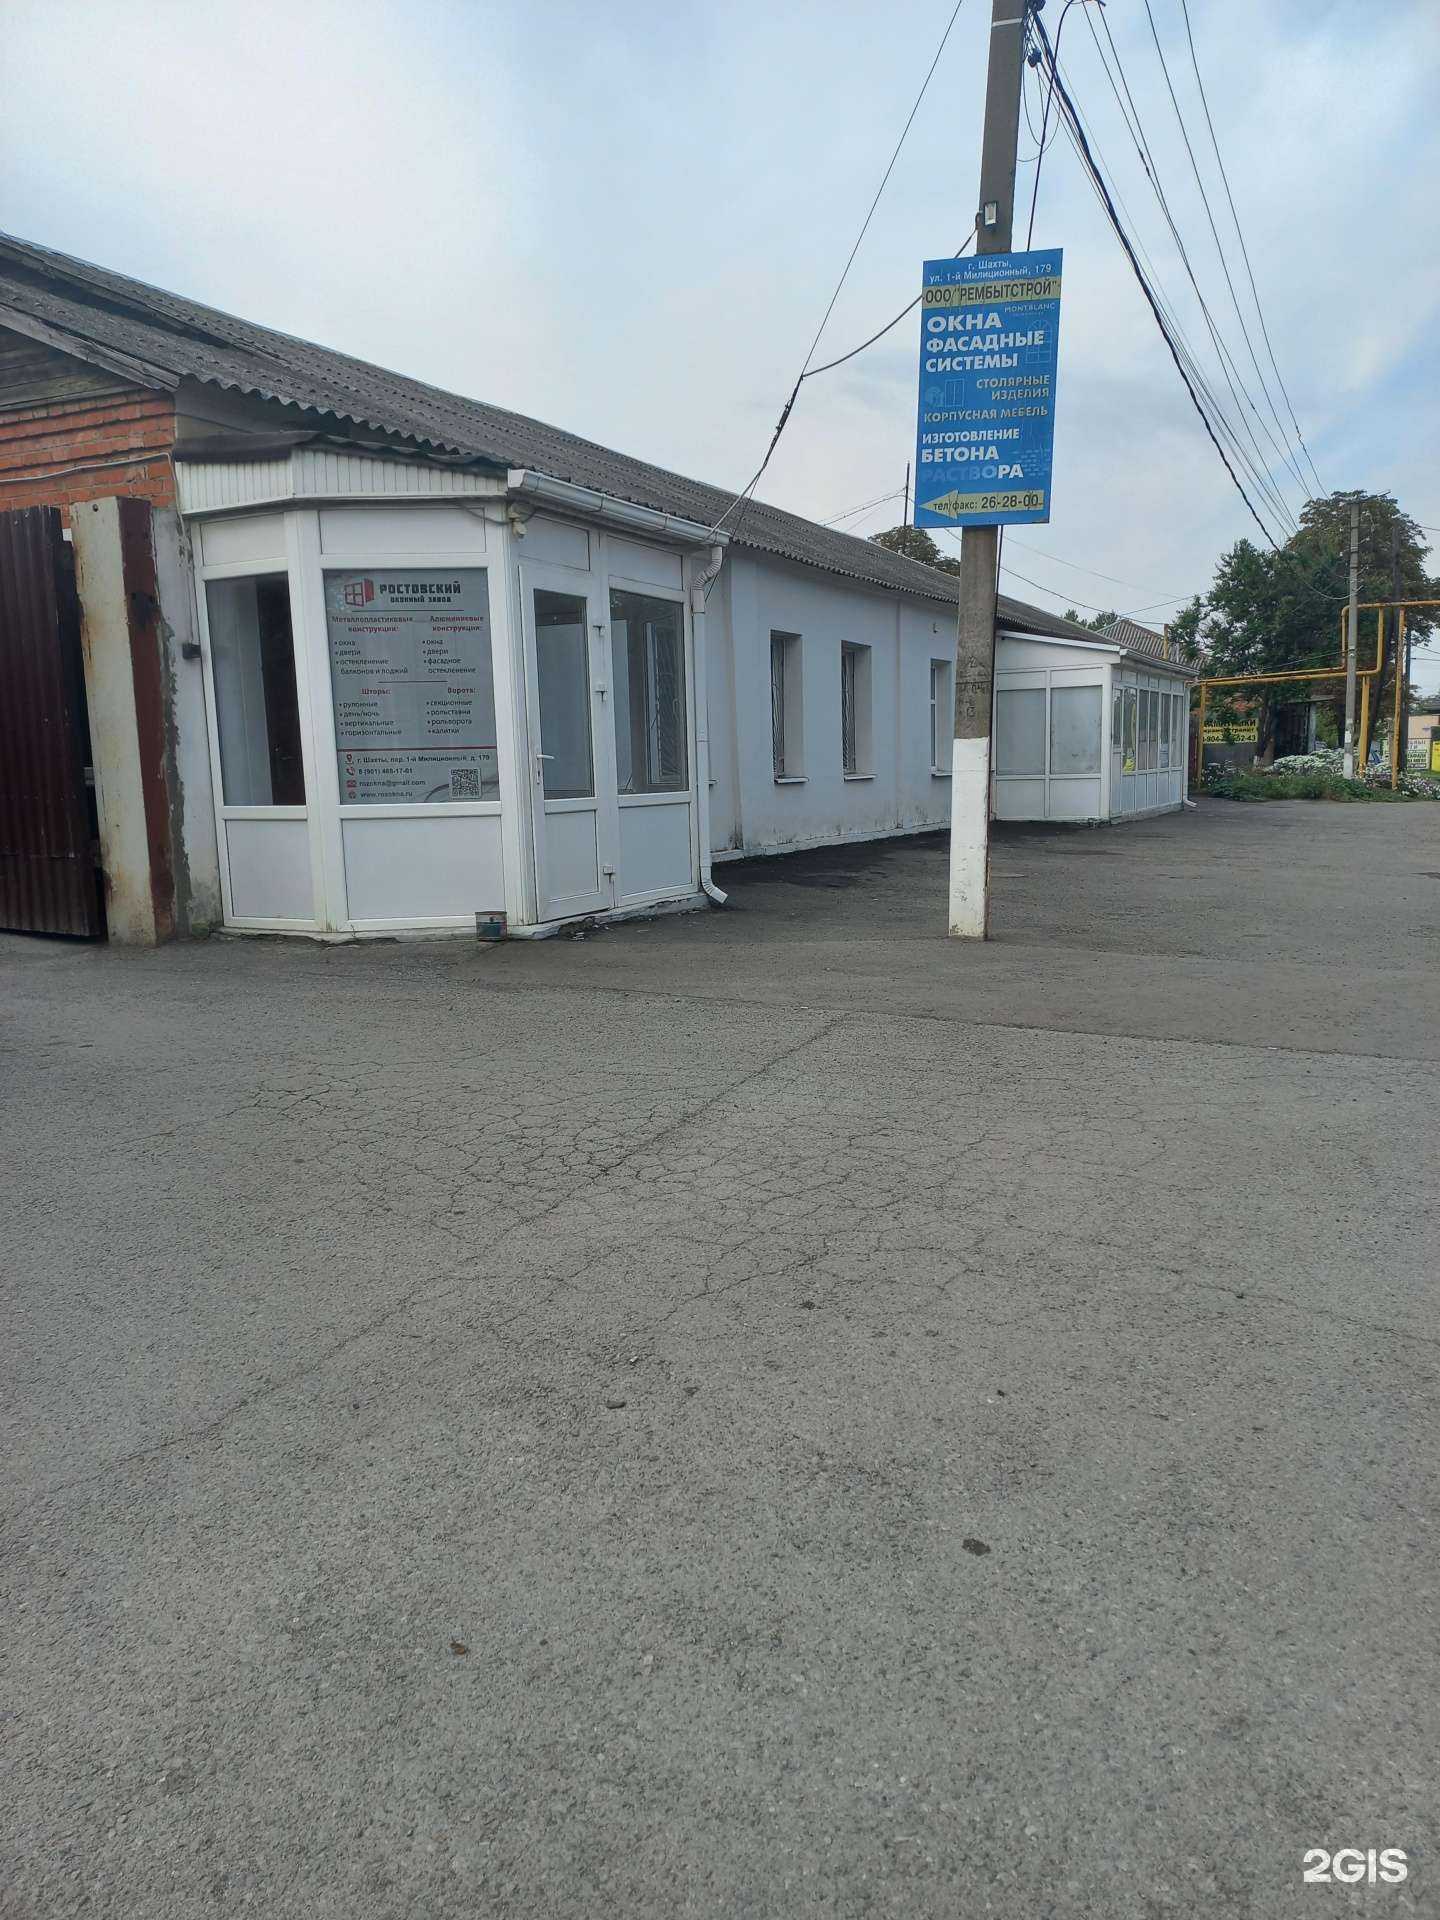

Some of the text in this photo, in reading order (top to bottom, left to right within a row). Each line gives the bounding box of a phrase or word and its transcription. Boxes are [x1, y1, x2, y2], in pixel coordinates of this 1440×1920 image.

[978, 260, 1012, 270] Шахты,
[929, 264, 1051, 284] ул. 1-й Милиционный, 179
[925, 288, 951, 303] ООО
[927, 312, 1002, 333] ОКНА
[926, 330, 1045, 353] ФАСАДНЫЕ
[925, 353, 1018, 373] СИСТЕМЫ
[976, 375, 1050, 389] СТОЛЯРНЫЕ
[991, 388, 1049, 401] ИЗДЕЛИЯ
[924, 406, 1048, 423] КОРПУСНАЯ МЕБЕЛЬ
[922, 428, 1020, 444] ИЗГОТОВЛЕНИЕ
[921, 446, 999, 463] БЕТОНА
[923, 463, 1024, 482] РАСТВОРА
[981, 494, 1039, 509] 26-28-00
[379, 580, 461, 594] РОСТОВСКИЙ
